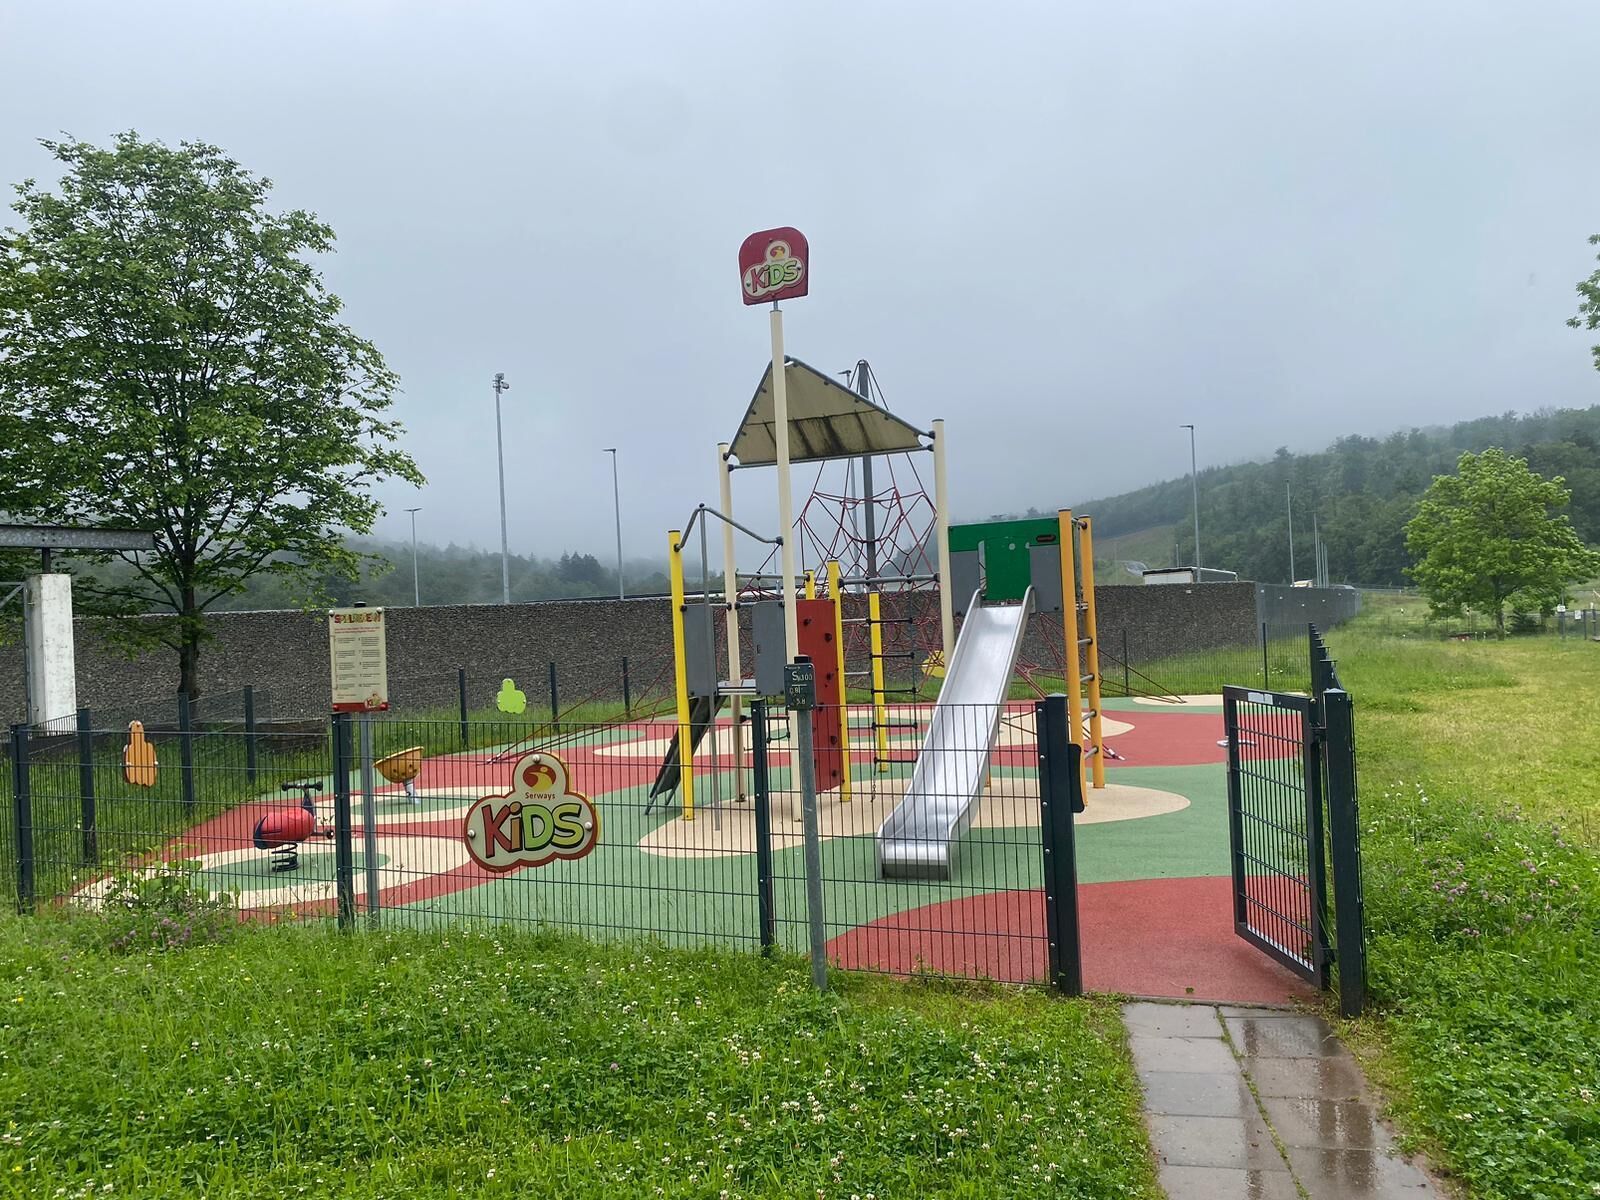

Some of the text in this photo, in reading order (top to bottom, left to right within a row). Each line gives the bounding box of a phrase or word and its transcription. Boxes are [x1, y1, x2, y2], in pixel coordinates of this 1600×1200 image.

[750, 260, 799, 293] KiDS
[524, 791, 556, 801] Serways
[481, 801, 585, 859] KiDS
